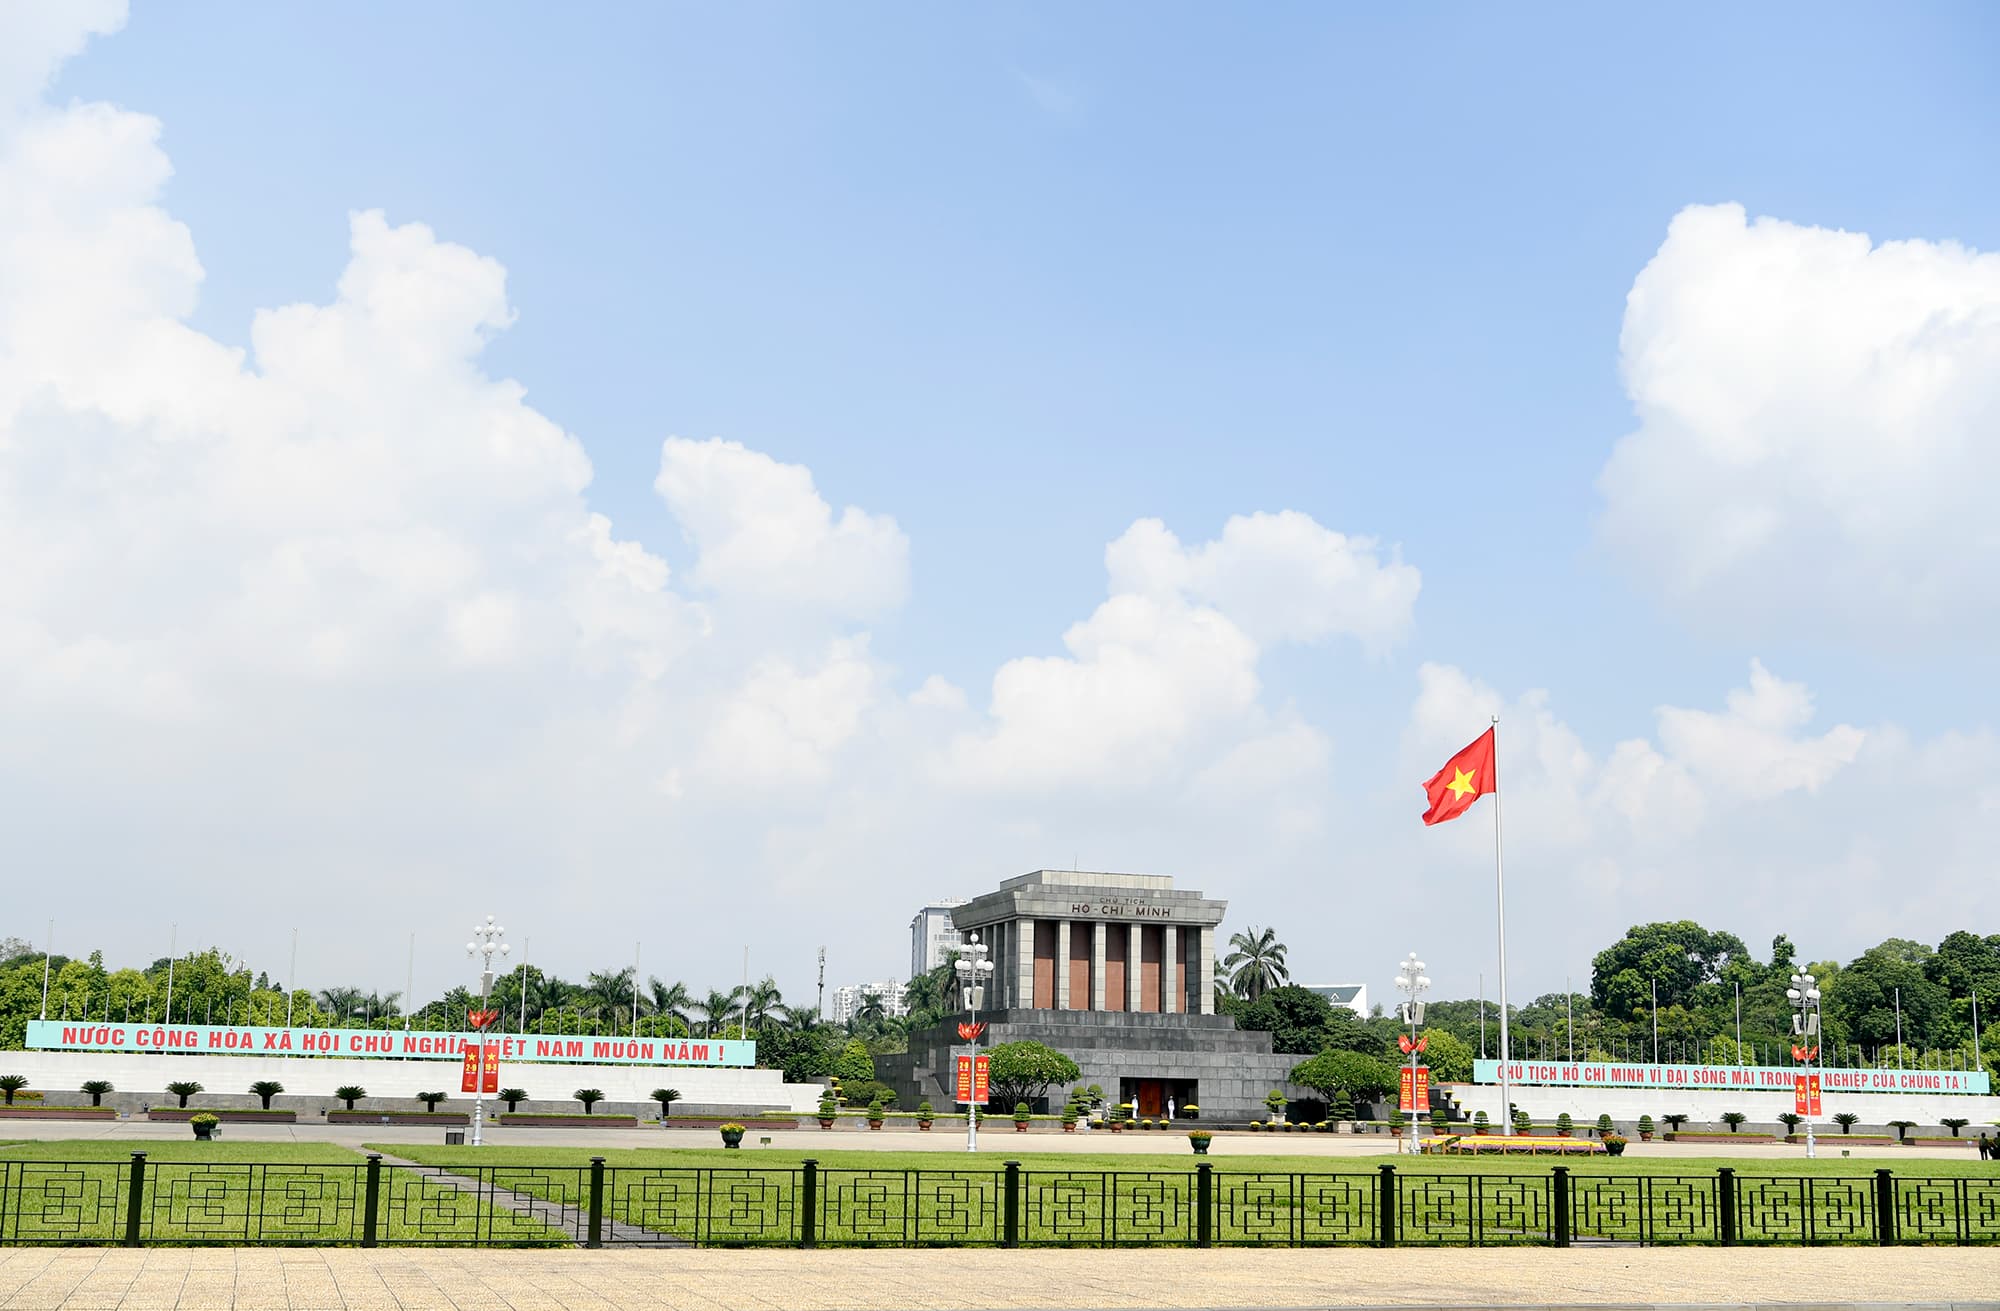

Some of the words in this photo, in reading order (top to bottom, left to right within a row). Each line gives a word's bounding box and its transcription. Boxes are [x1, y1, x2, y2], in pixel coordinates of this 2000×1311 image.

[62, 1025, 125, 1046] NƯỚC
[136, 1027, 198, 1050] CỘNG
[208, 1029, 253, 1049] HÒA
[264, 1029, 292, 1050] XÃ
[302, 1031, 340, 1054] HỘI
[349, 1031, 393, 1053] CHỦ
[536, 1040, 584, 1057] NAM
[593, 1038, 653, 1060] MUÔN
[663, 1039, 709, 1061] NĂM
[719, 1045, 724, 1061] !
[1529, 1065, 1557, 1083] TỊCH
[1584, 1064, 1606, 1082] CHÍ
[1611, 1067, 1645, 1082] MINH
[1666, 1069, 1688, 1086] ĐẠI
[1693, 1065, 1727, 1085] SỐNG
[1825, 1071, 1869, 1090] NGHIỆP
[1873, 1071, 1896, 1088] CỦA
[1901, 1073, 1941, 1089] CHÚNG
[1945, 1076, 1959, 1089] TA
[1964, 1076, 1968, 1089] !
